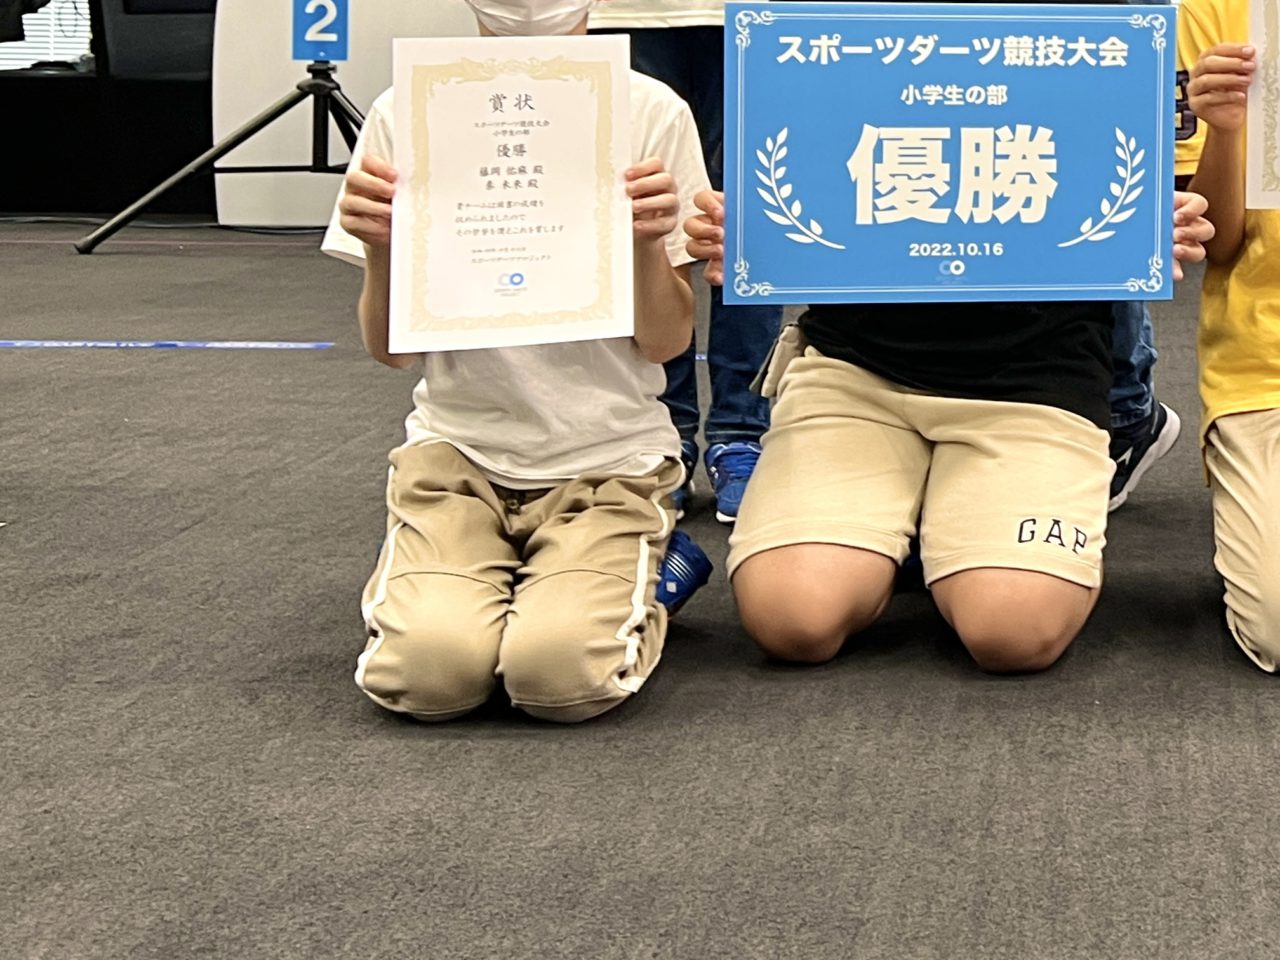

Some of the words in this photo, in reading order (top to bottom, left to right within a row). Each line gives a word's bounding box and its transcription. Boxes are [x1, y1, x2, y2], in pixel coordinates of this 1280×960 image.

[775, 34, 1129, 67] スポーツダーツ競技大会
[489, 94, 535, 113] 賞状
[900, 84, 1009, 106] 小学生の部
[496, 144, 527, 157] 優勝
[846, 123, 1058, 226] 優勝
[909, 243, 1003, 257] 2022.10.16
[1017, 518, 1088, 555] GAP
